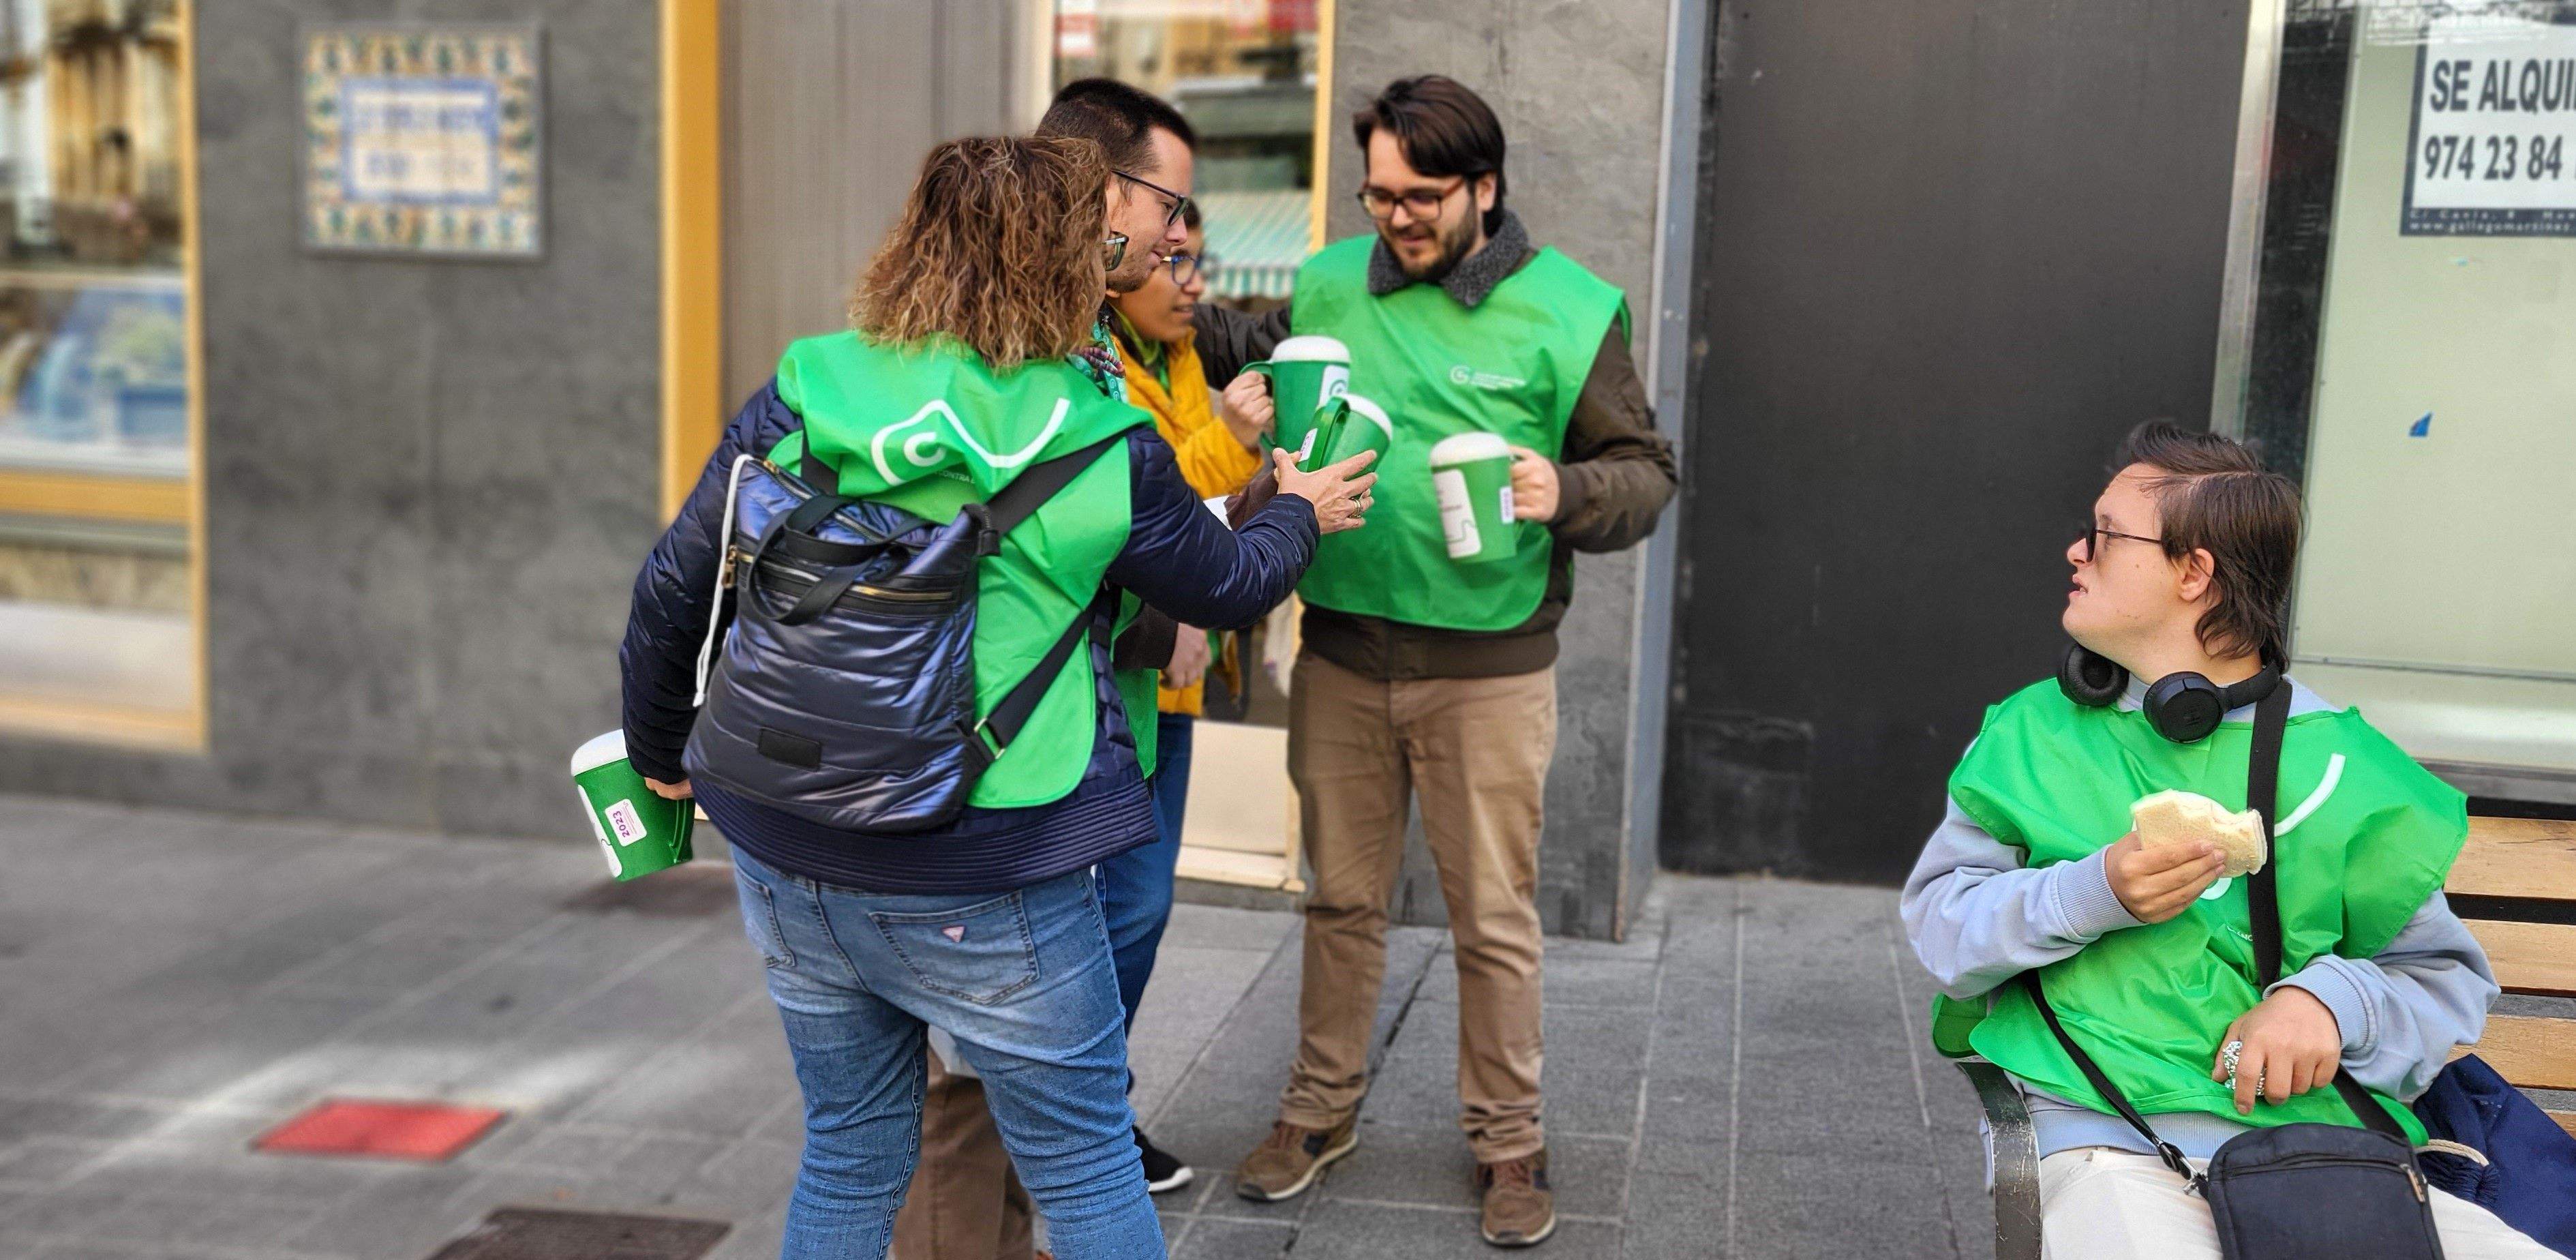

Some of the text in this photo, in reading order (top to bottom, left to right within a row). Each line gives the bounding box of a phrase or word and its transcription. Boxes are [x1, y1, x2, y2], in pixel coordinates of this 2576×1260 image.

[2429, 59, 2576, 115] SE ALQUI
[2424, 134, 2476, 180] 974
[2483, 134, 2519, 181] 23
[2526, 134, 2564, 181] 84
[612, 810, 631, 838] 2023
